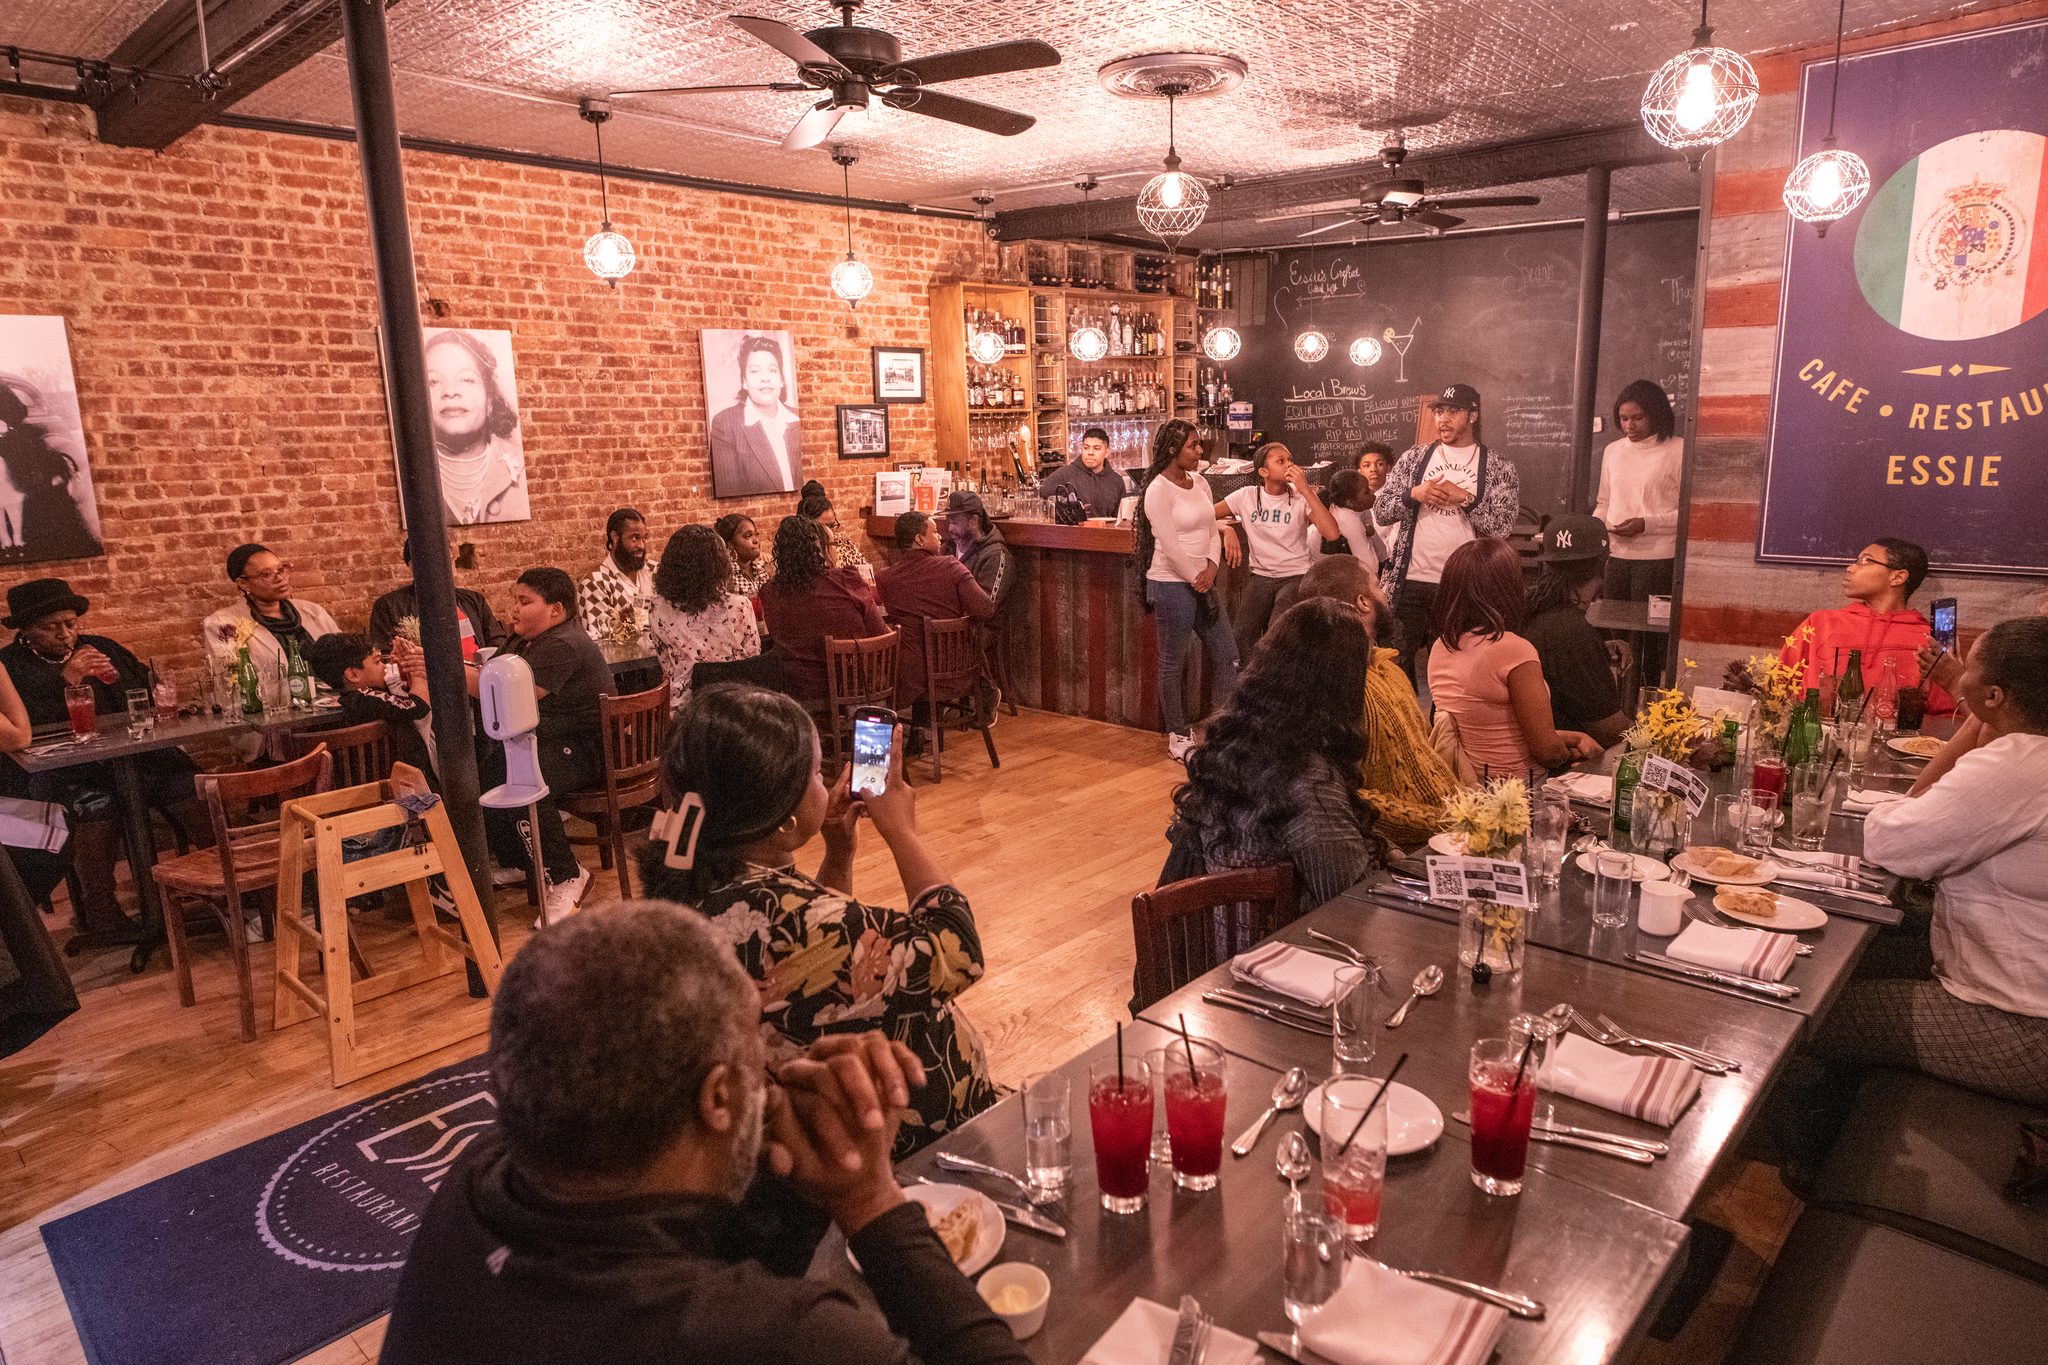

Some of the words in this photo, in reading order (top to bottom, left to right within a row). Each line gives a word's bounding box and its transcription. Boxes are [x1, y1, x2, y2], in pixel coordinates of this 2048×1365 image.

[1293, 381, 1326, 399] Local
[1330, 378, 1366, 397] Brews
[1443, 387, 1456, 398] NY
[1799, 358, 1870, 414] CAFE
[1908, 383, 2048, 431] RESTAU
[1285, 402, 1343, 418] EQUILIBRIUM
[1364, 399, 1398, 412] BELGIAN
[1401, 396, 1420, 407] WHIT
[1318, 418, 1336, 429] PALE
[1342, 415, 1359, 428] ALE
[1364, 413, 1398, 427] SHOCK
[1325, 429, 1341, 440] RIP
[1345, 429, 1362, 440] VAN
[1886, 455, 2001, 487] ESSIE
[1251, 509, 1291, 525] SOHO
[1428, 503, 1456, 517] TTERS
[1556, 529, 1572, 549] NY
[356, 1090, 497, 1194] ESS
